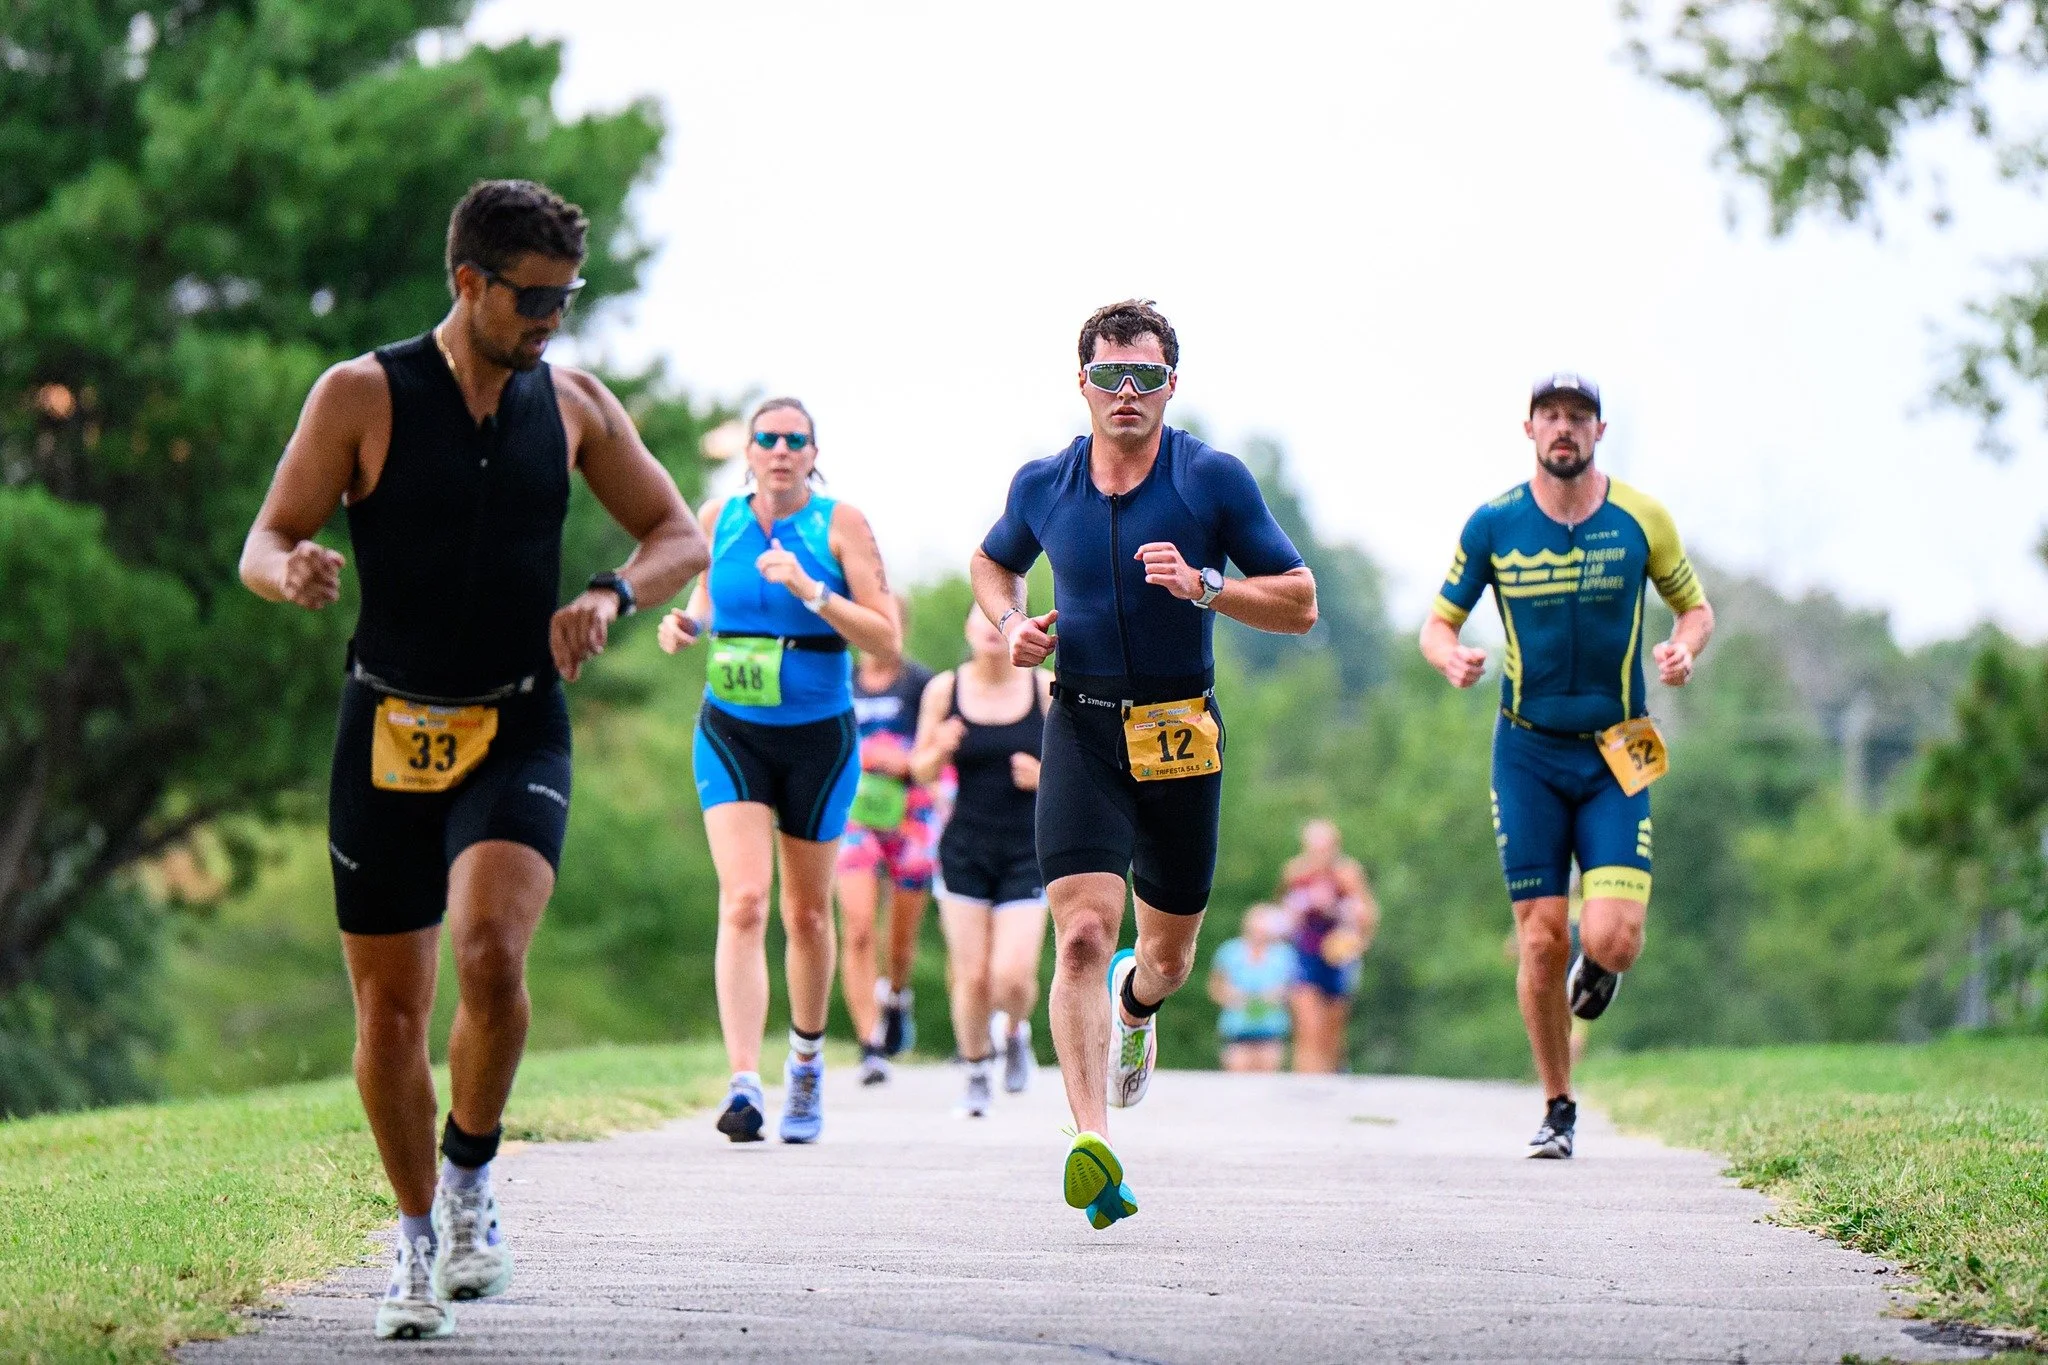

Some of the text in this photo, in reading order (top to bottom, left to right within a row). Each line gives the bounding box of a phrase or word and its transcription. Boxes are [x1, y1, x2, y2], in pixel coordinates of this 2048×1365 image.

[721, 664, 763, 690] 348
[409, 731, 457, 772] 33
[1157, 728, 1194, 763] 12
[1626, 739, 1658, 771] 52
[1155, 764, 1200, 775] TRIFESTA 54.5
